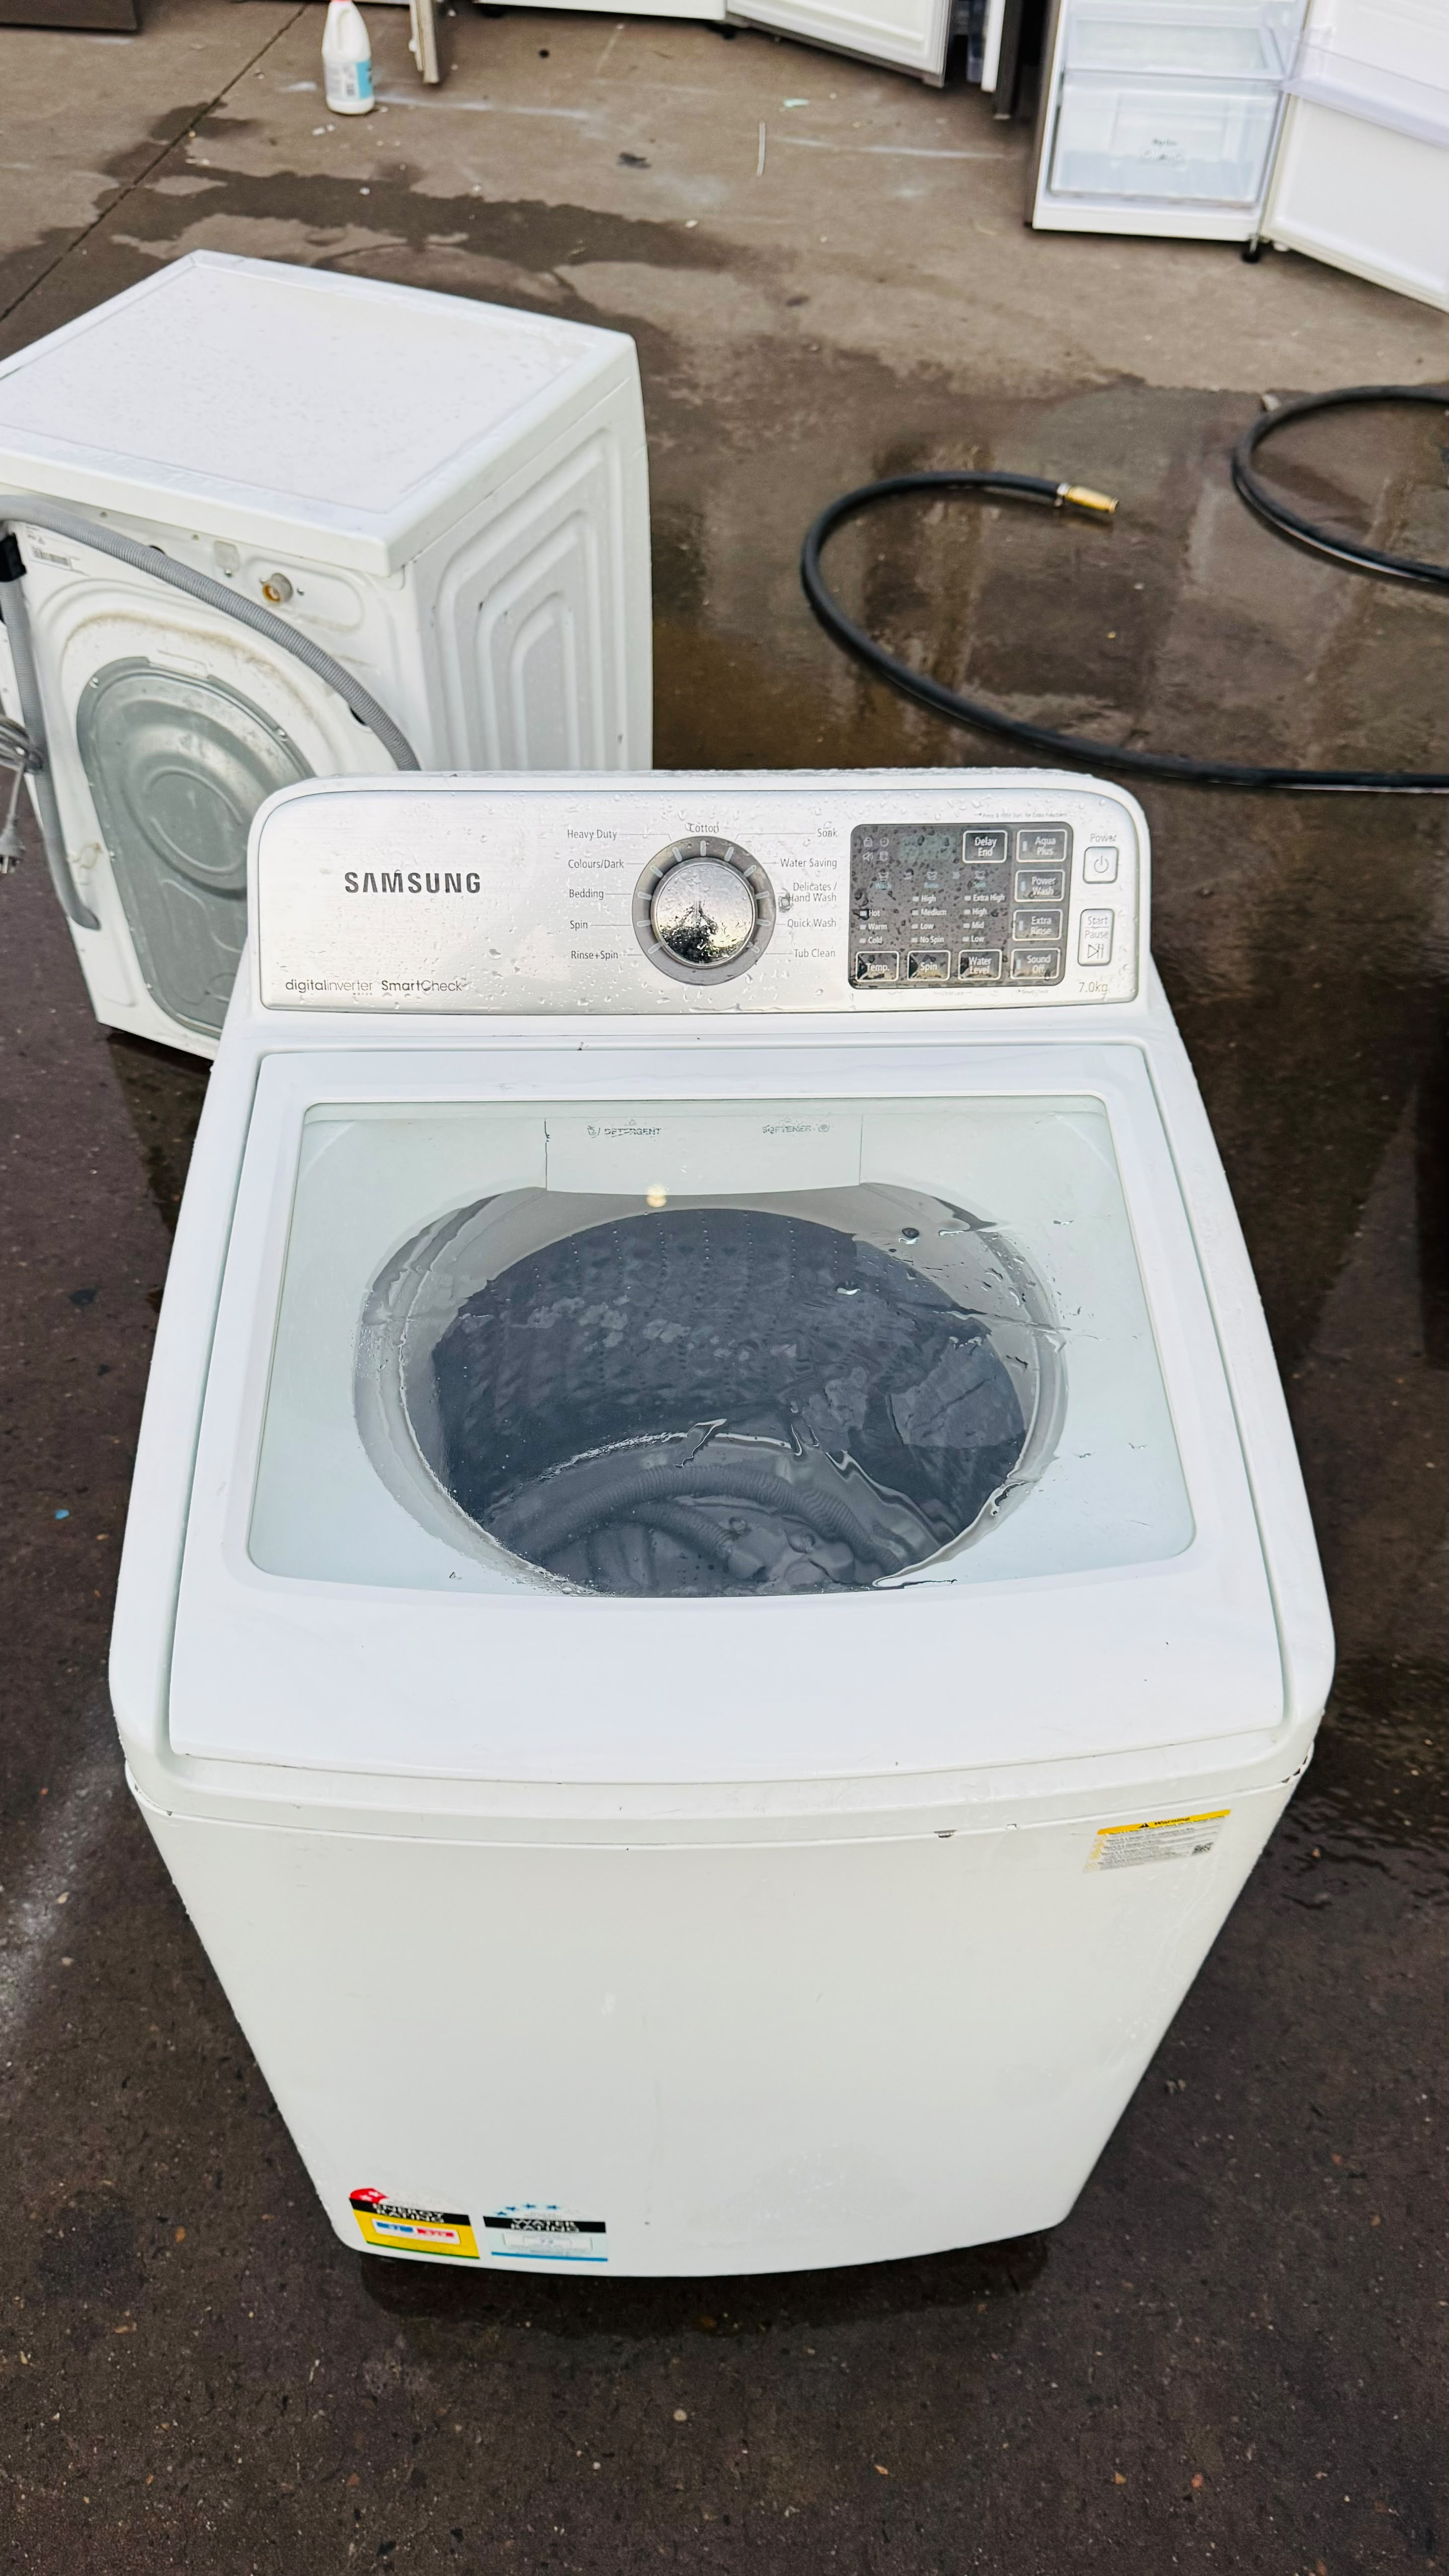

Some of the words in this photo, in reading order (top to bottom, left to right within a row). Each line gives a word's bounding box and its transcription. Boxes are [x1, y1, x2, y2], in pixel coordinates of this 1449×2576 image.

[688, 824, 719, 833] Cotton
[817, 828, 838, 838] Soak
[568, 830, 595, 841] Heavy
[597, 830, 617, 841] Duty
[1090, 833, 1117, 842] Power
[975, 837, 997, 849] Delay
[1035, 837, 1056, 847] Aqua
[978, 848, 993, 857] End
[1036, 846, 1054, 856] Plus
[568, 859, 624, 869] Colours/Dark
[780, 858, 807, 867] Water
[809, 858, 837, 869] Saving
[345, 872, 481, 894] SAMSUNG
[1031, 876, 1056, 886] Power
[793, 882, 831, 892] Delicates
[1032, 886, 1055, 896] Wash
[569, 889, 604, 901] Bedding
[788, 893, 810, 902] Hand
[813, 893, 837, 902] Wash
[921, 894, 936, 903] High
[973, 893, 988, 902] Extra
[990, 893, 1005, 903] High
[868, 909, 880, 917] Hot
[921, 908, 947, 916] Medium
[972, 907, 988, 917] High
[570, 920, 589, 931] Spin
[787, 918, 811, 929] Quick
[813, 918, 837, 928] Wash
[972, 921, 985, 929] Mid
[1031, 916, 1052, 926] Extra
[1087, 916, 1108, 925] Start
[868, 923, 888, 931] Warm
[920, 922, 934, 930] Low
[1030, 926, 1052, 936] Rinse
[971, 935, 985, 943] Low
[1084, 930, 1109, 939] Pause
[868, 936, 883, 944] Cold
[920, 936, 929, 944] No
[930, 935, 944, 945] Spin
[571, 950, 619, 961] Rinse+Spin
[794, 948, 809, 958] Tub
[811, 948, 836, 957] Clean
[968, 956, 992, 965] Water
[1026, 954, 1052, 964] Sound
[866, 963, 890, 974] Temp.
[920, 961, 938, 974] Spin
[969, 964, 990, 975] Level
[1032, 964, 1045, 974] Off
[381, 980, 463, 991] SmartCheck
[1078, 981, 1109, 994] 7.0kg
